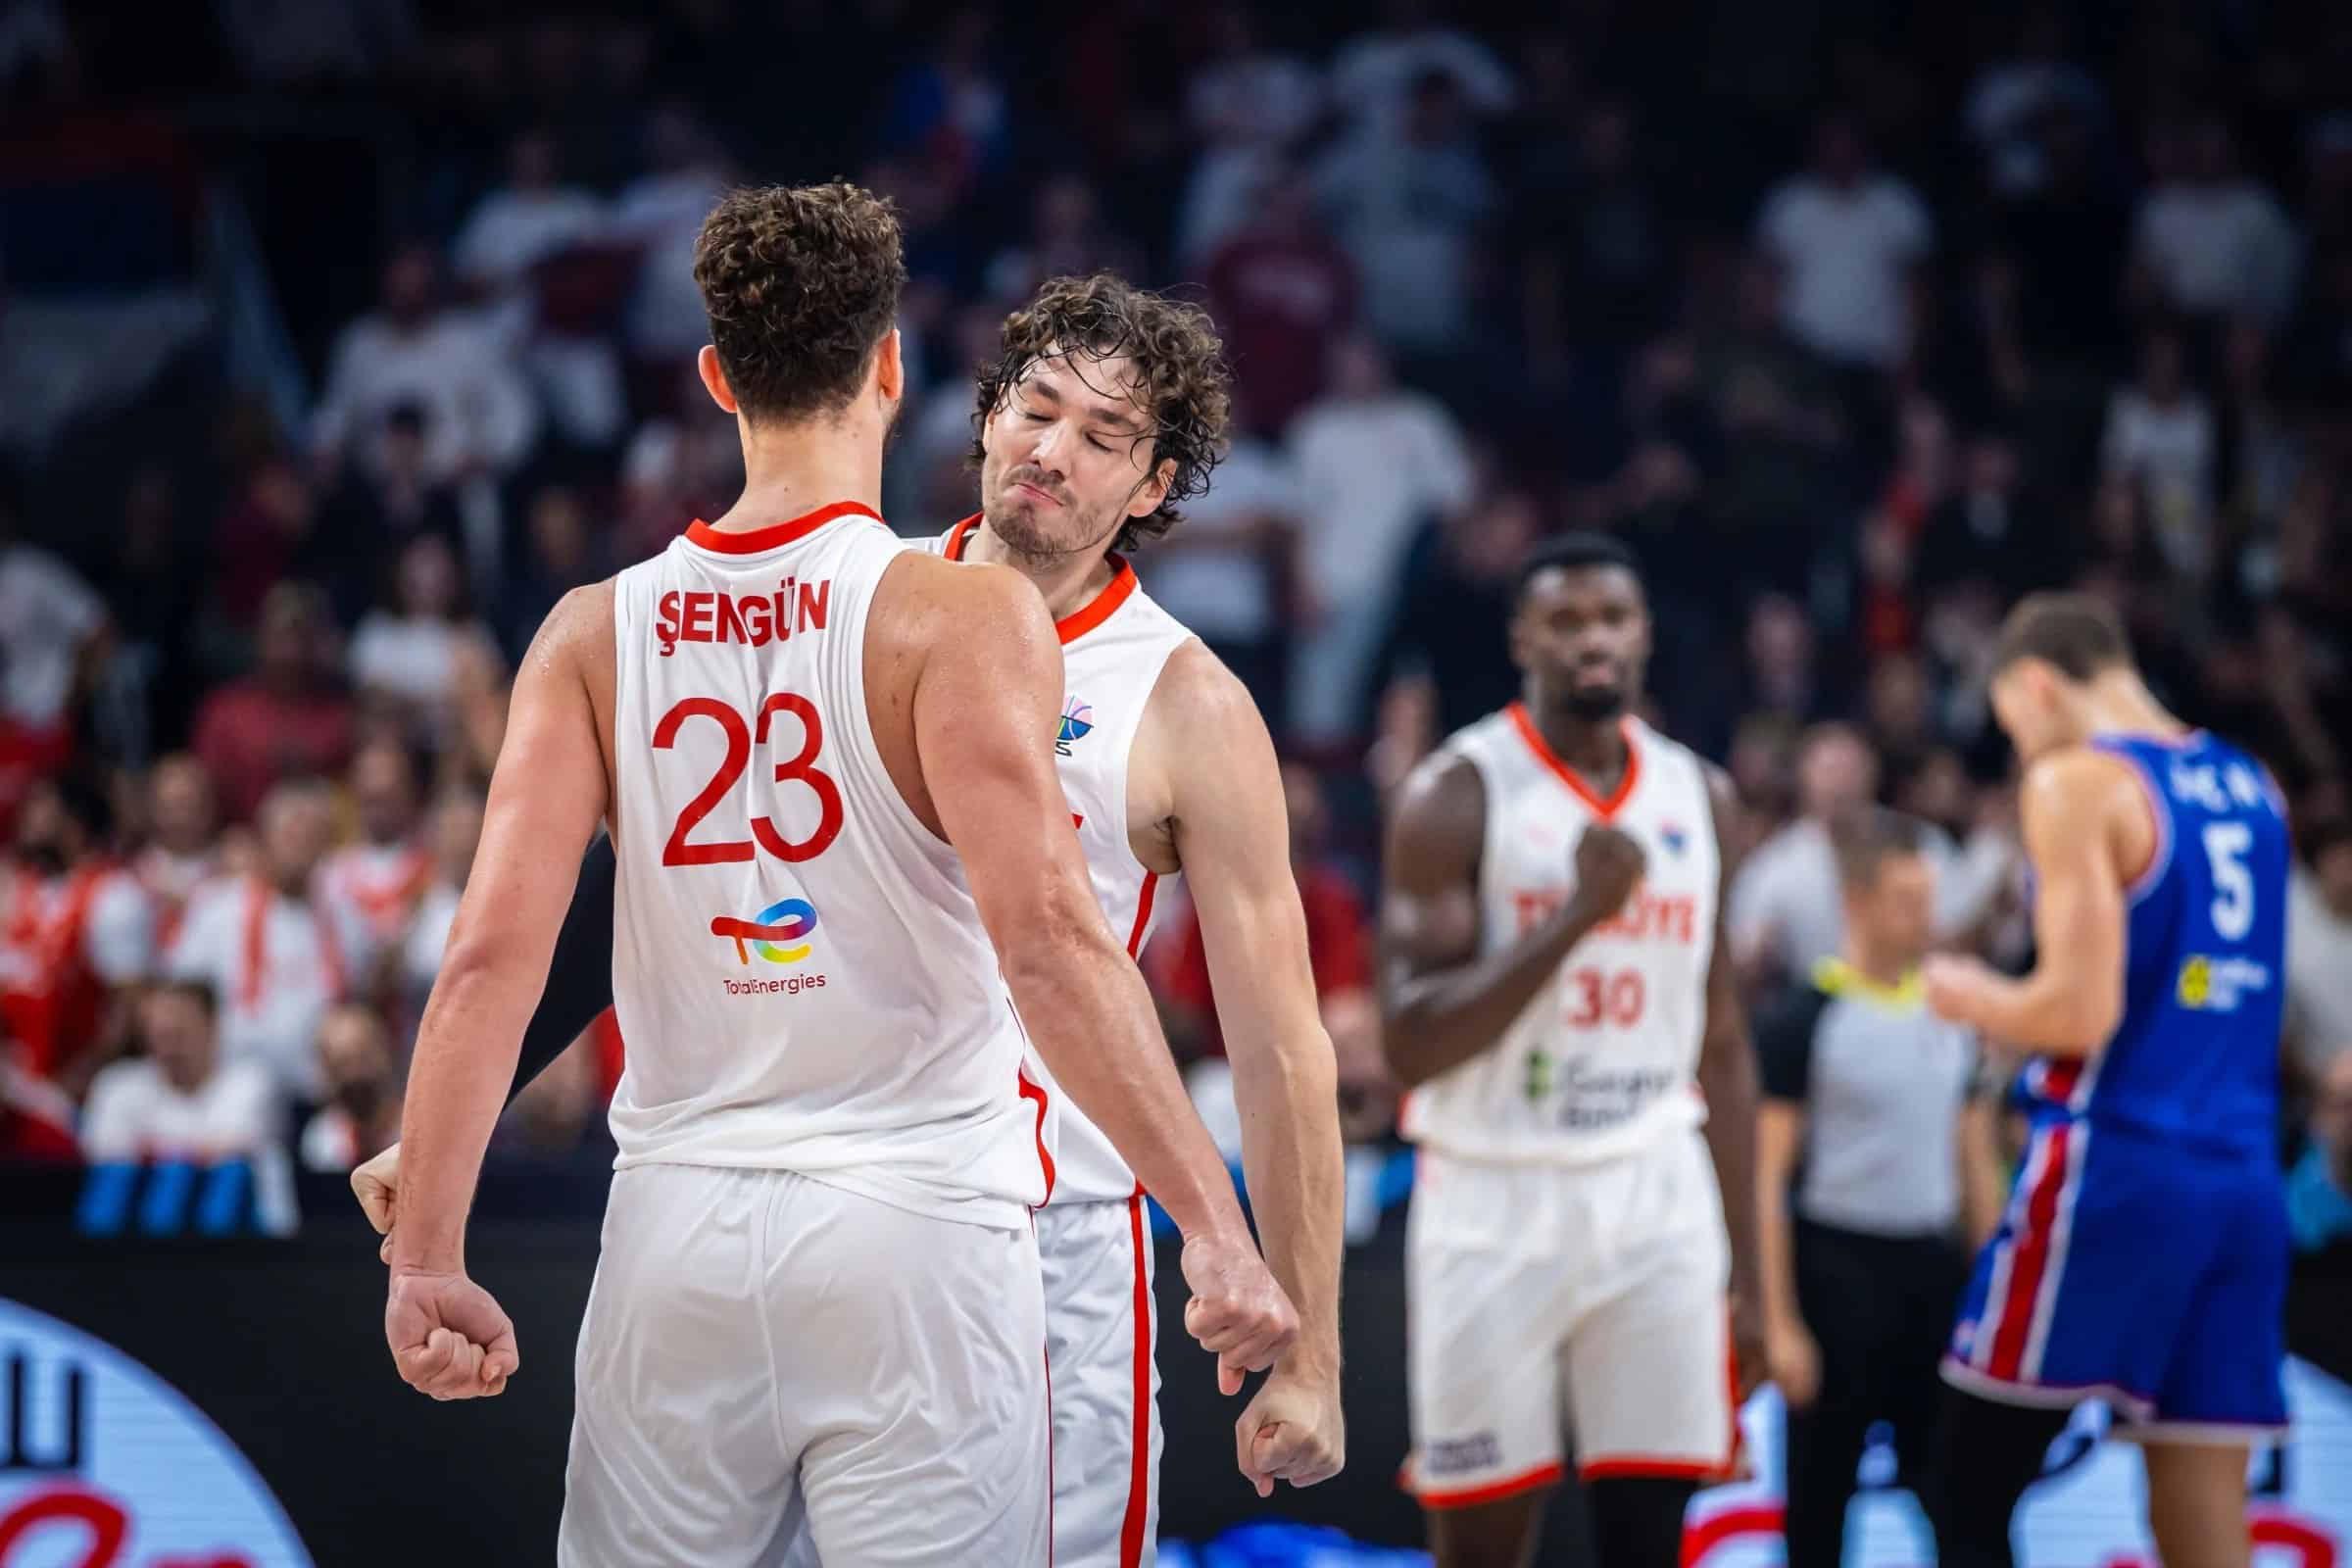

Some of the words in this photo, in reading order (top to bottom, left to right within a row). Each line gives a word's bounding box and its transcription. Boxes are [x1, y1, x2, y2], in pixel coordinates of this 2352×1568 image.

[656, 575, 831, 658] ŞENGÜN
[652, 692, 844, 867] 23
[2201, 820, 2254, 942] 5
[1565, 965, 1646, 1032] 30
